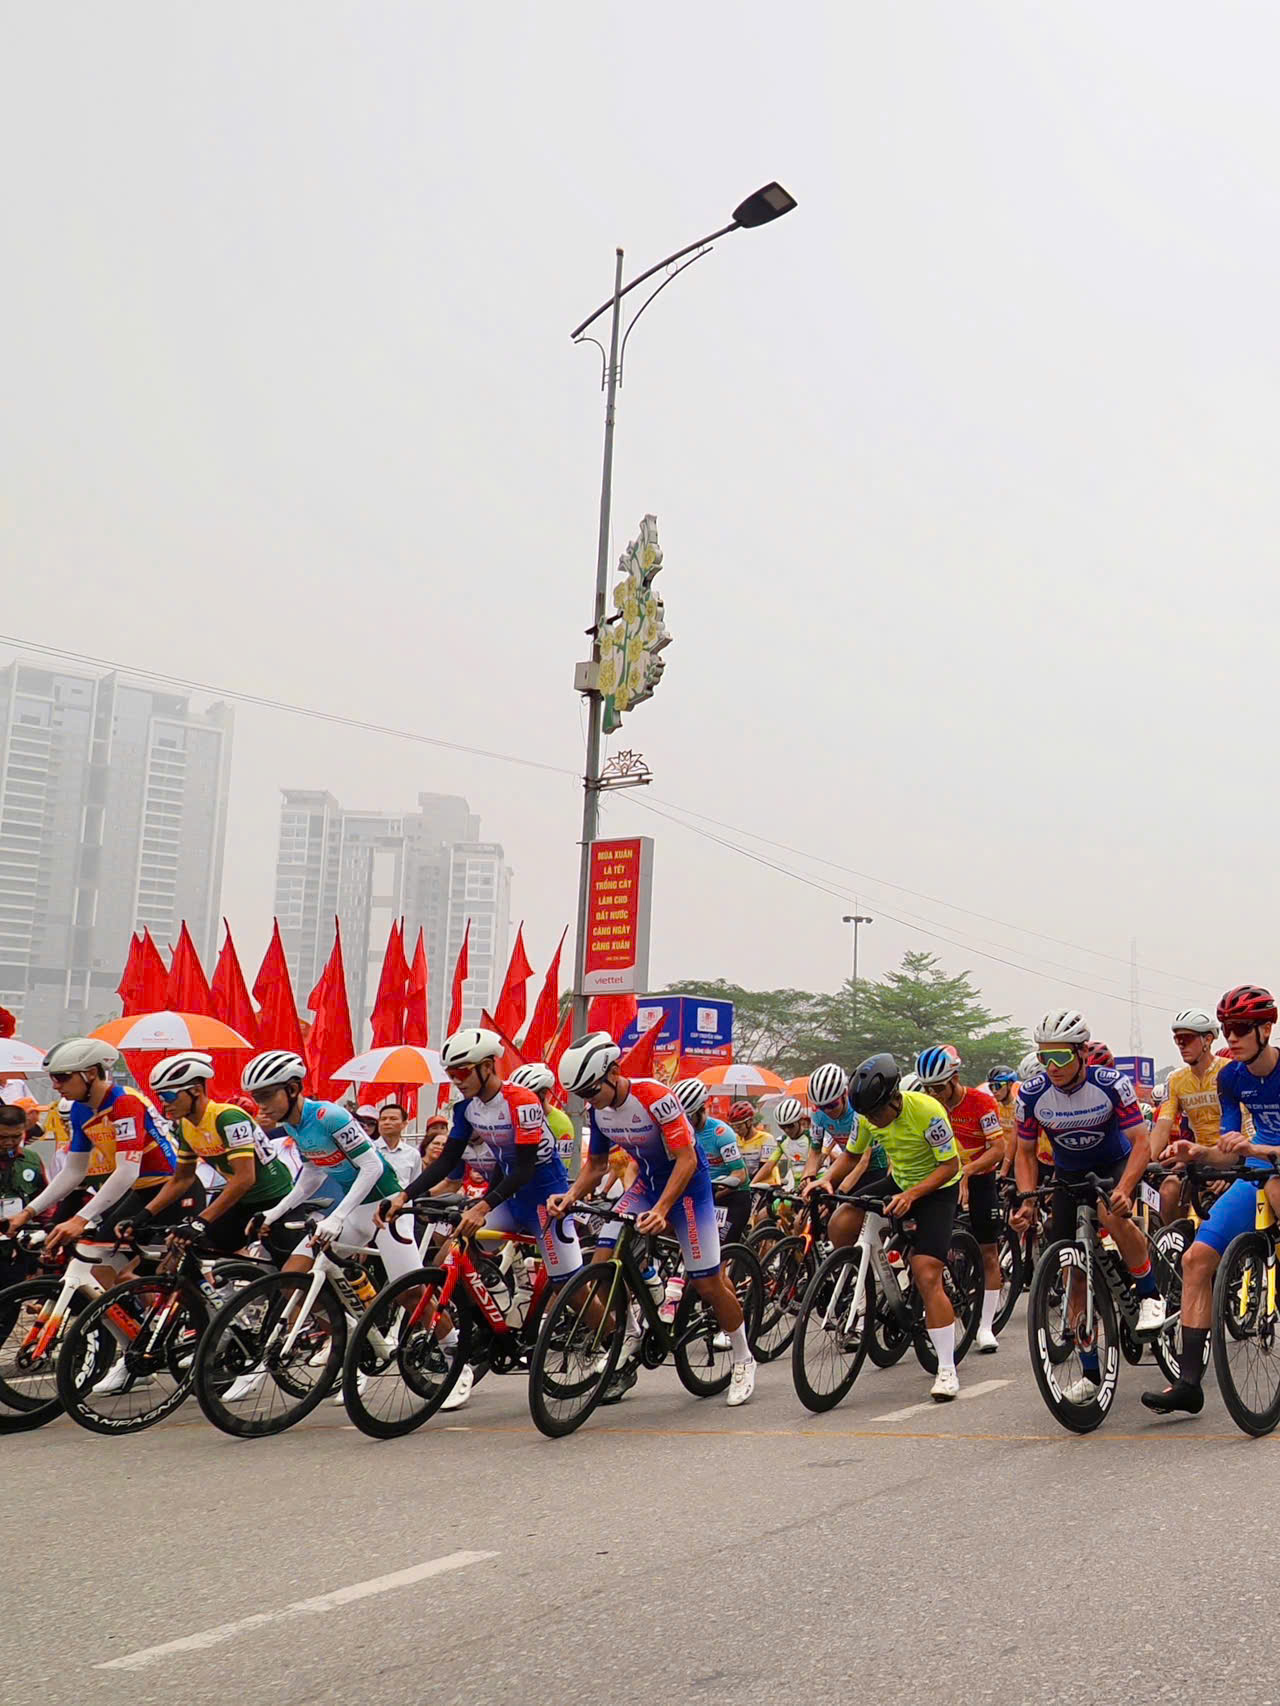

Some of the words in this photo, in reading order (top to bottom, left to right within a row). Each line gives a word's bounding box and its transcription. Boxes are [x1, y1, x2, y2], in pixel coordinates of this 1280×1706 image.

[594, 975, 625, 985] viettel
[1121, 1080, 1132, 1097] 9
[522, 1107, 542, 1123] 102
[654, 1099, 678, 1119] 104
[232, 1125, 249, 1141] 42
[340, 1127, 360, 1145] 22
[930, 1127, 947, 1141] 65
[1063, 1134, 1097, 1146] BM
[724, 1146, 737, 1158] 26
[714, 1208, 725, 1220] 04
[465, 1272, 504, 1323] NESTO
